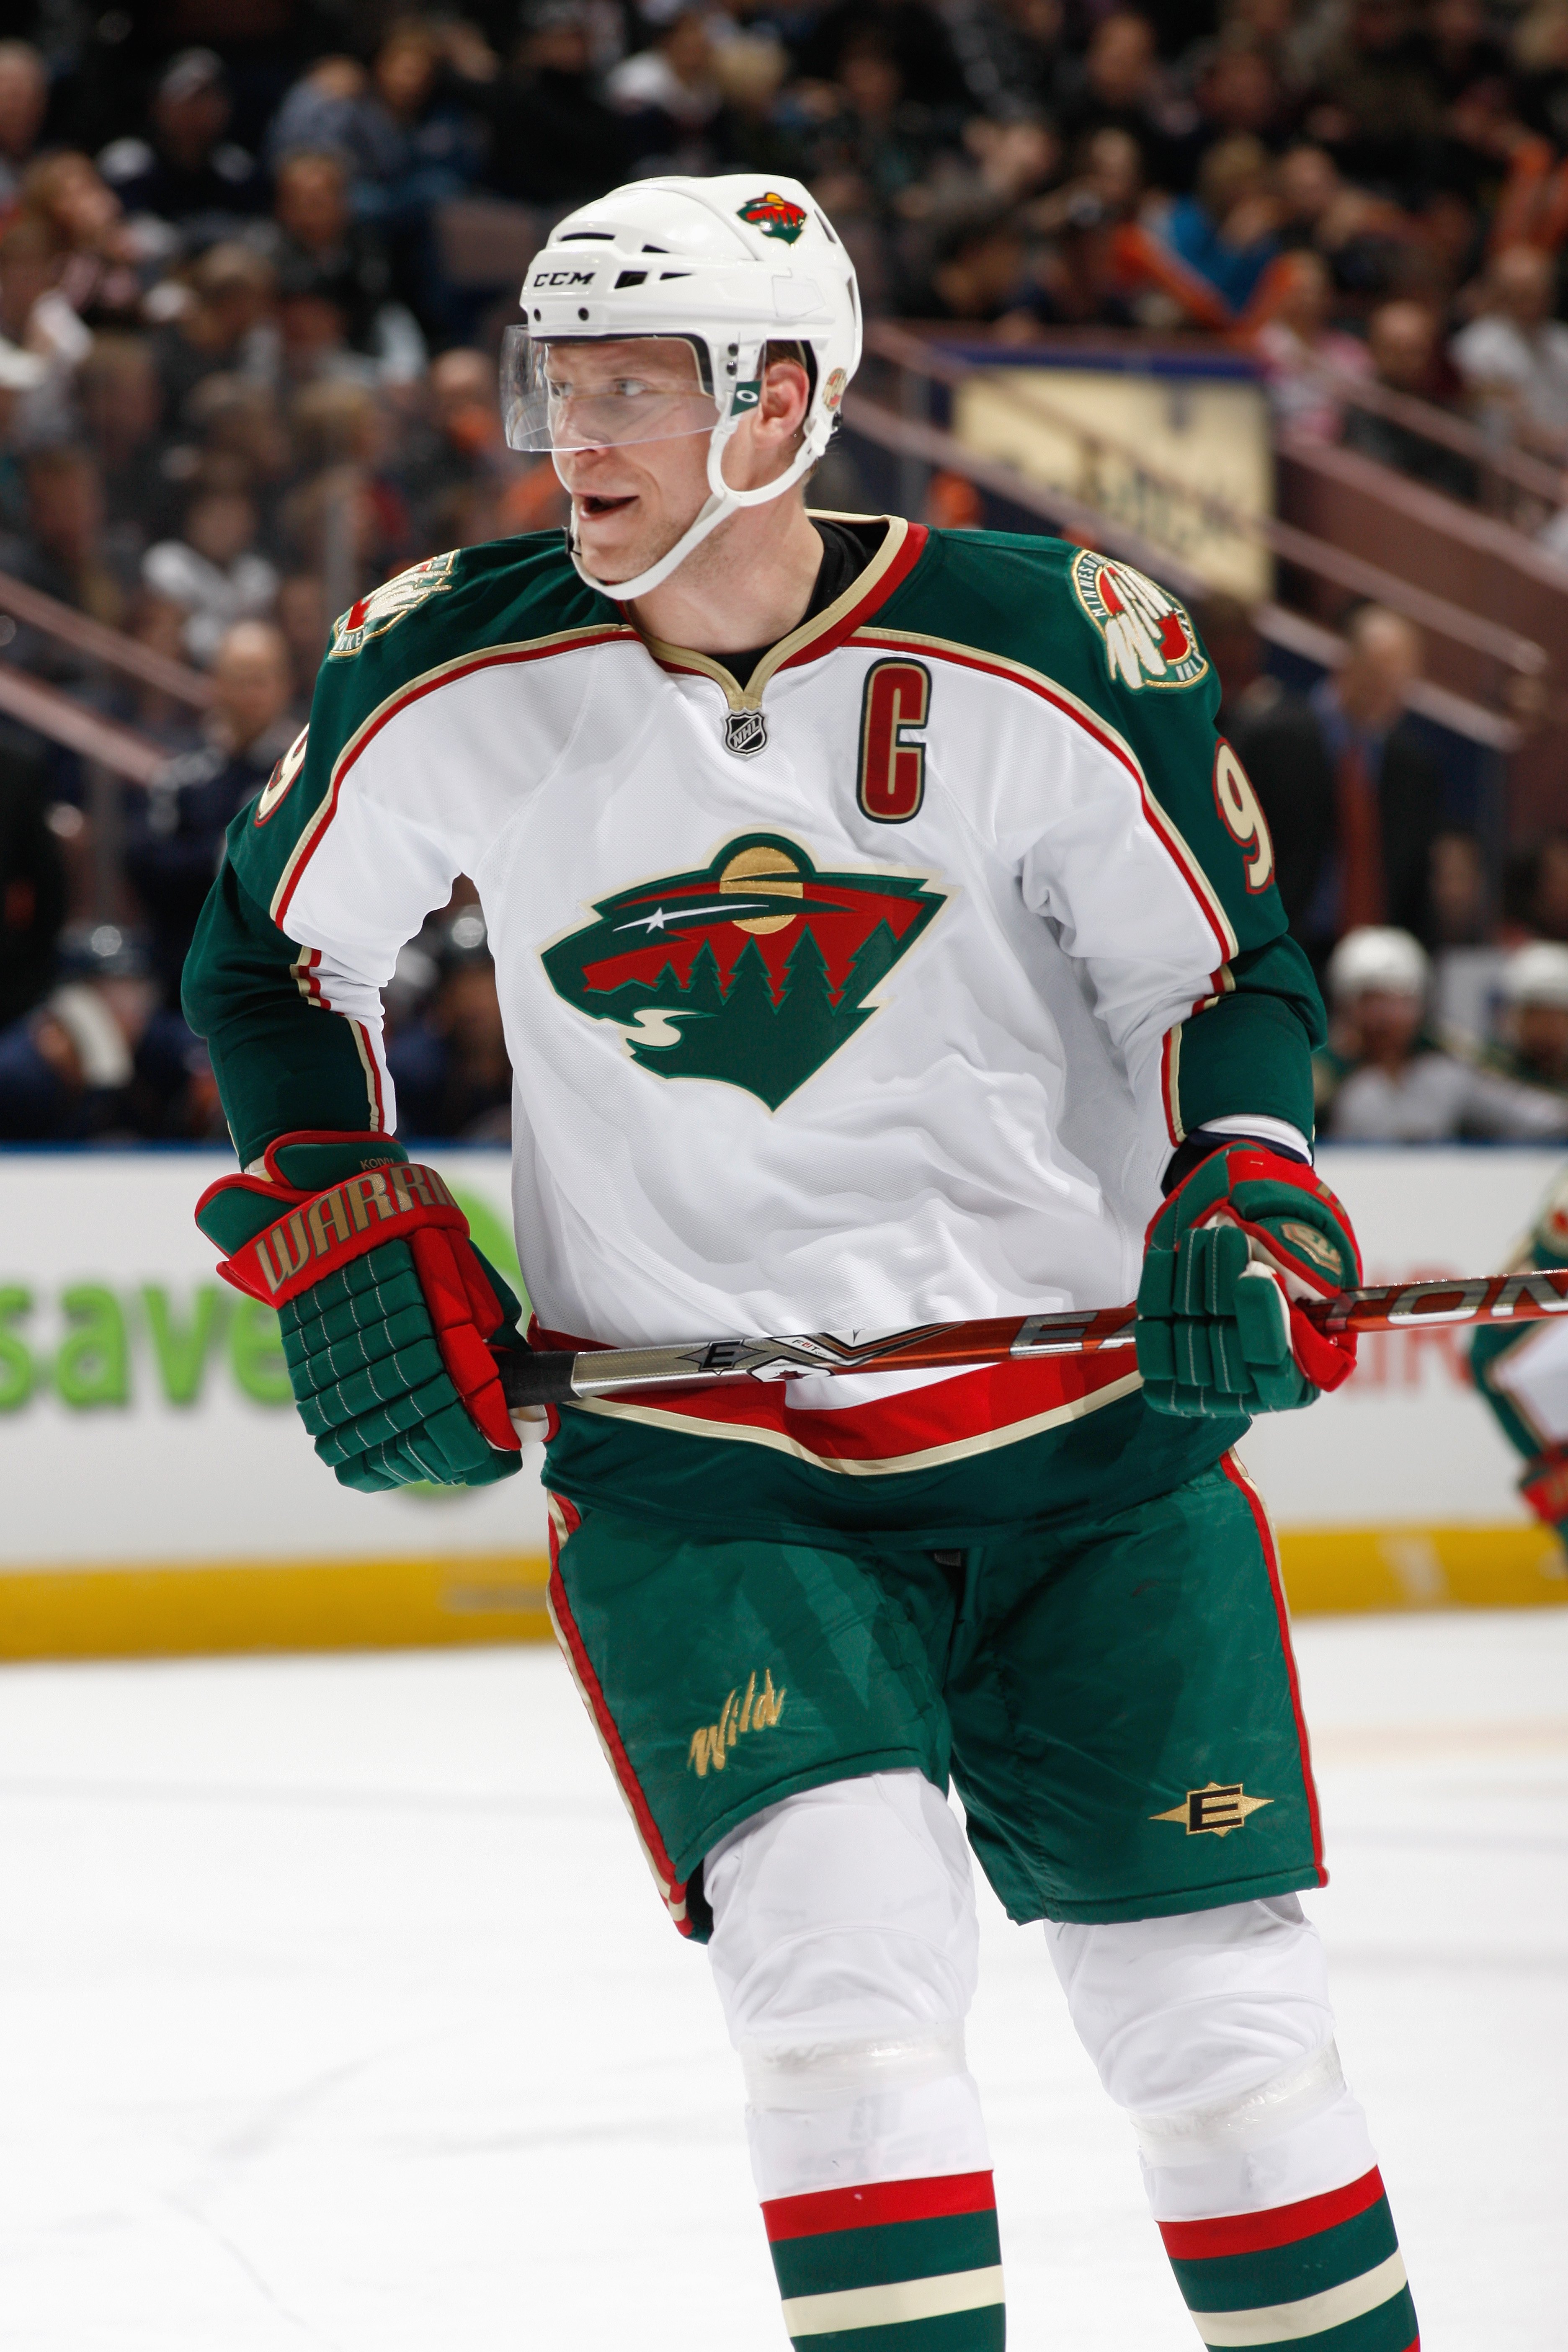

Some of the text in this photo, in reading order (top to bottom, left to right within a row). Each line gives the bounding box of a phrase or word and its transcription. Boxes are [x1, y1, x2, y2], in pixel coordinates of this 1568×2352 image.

[534, 272, 596, 287] CCM
[1078, 554, 1106, 617] MINNESO
[733, 720, 760, 748] NHL
[857, 657, 932, 824] C
[1212, 737, 1275, 895] 9
[255, 1165, 461, 1295] WARRI
[687, 1668, 786, 1776] Wild
[1189, 1787, 1243, 1831] E
